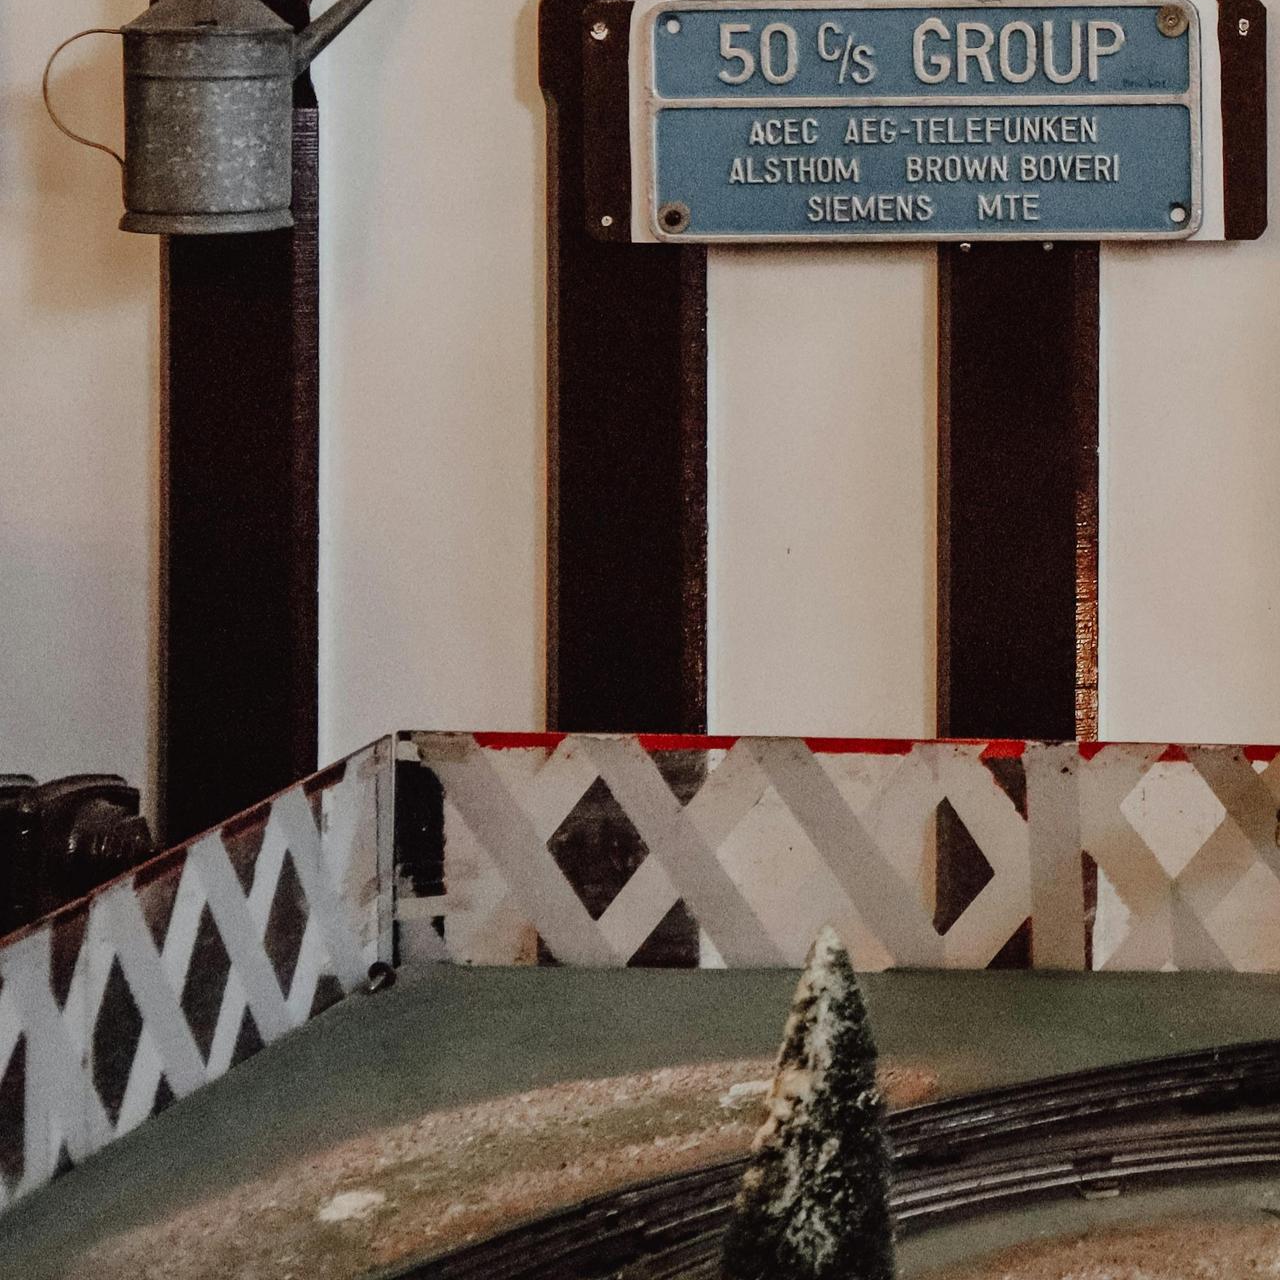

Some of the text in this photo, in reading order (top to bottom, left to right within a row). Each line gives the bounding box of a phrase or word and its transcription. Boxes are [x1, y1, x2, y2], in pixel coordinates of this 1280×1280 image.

[717, 22, 799, 86] 50
[912, 17, 1126, 85] GROUP
[748, 116, 1098, 146] ACEC AEG-TELEFUNKEN
[728, 154, 1120, 185] ALSTHOM BROWN BOVERI
[806, 193, 1040, 222] SIEMENS MTE
